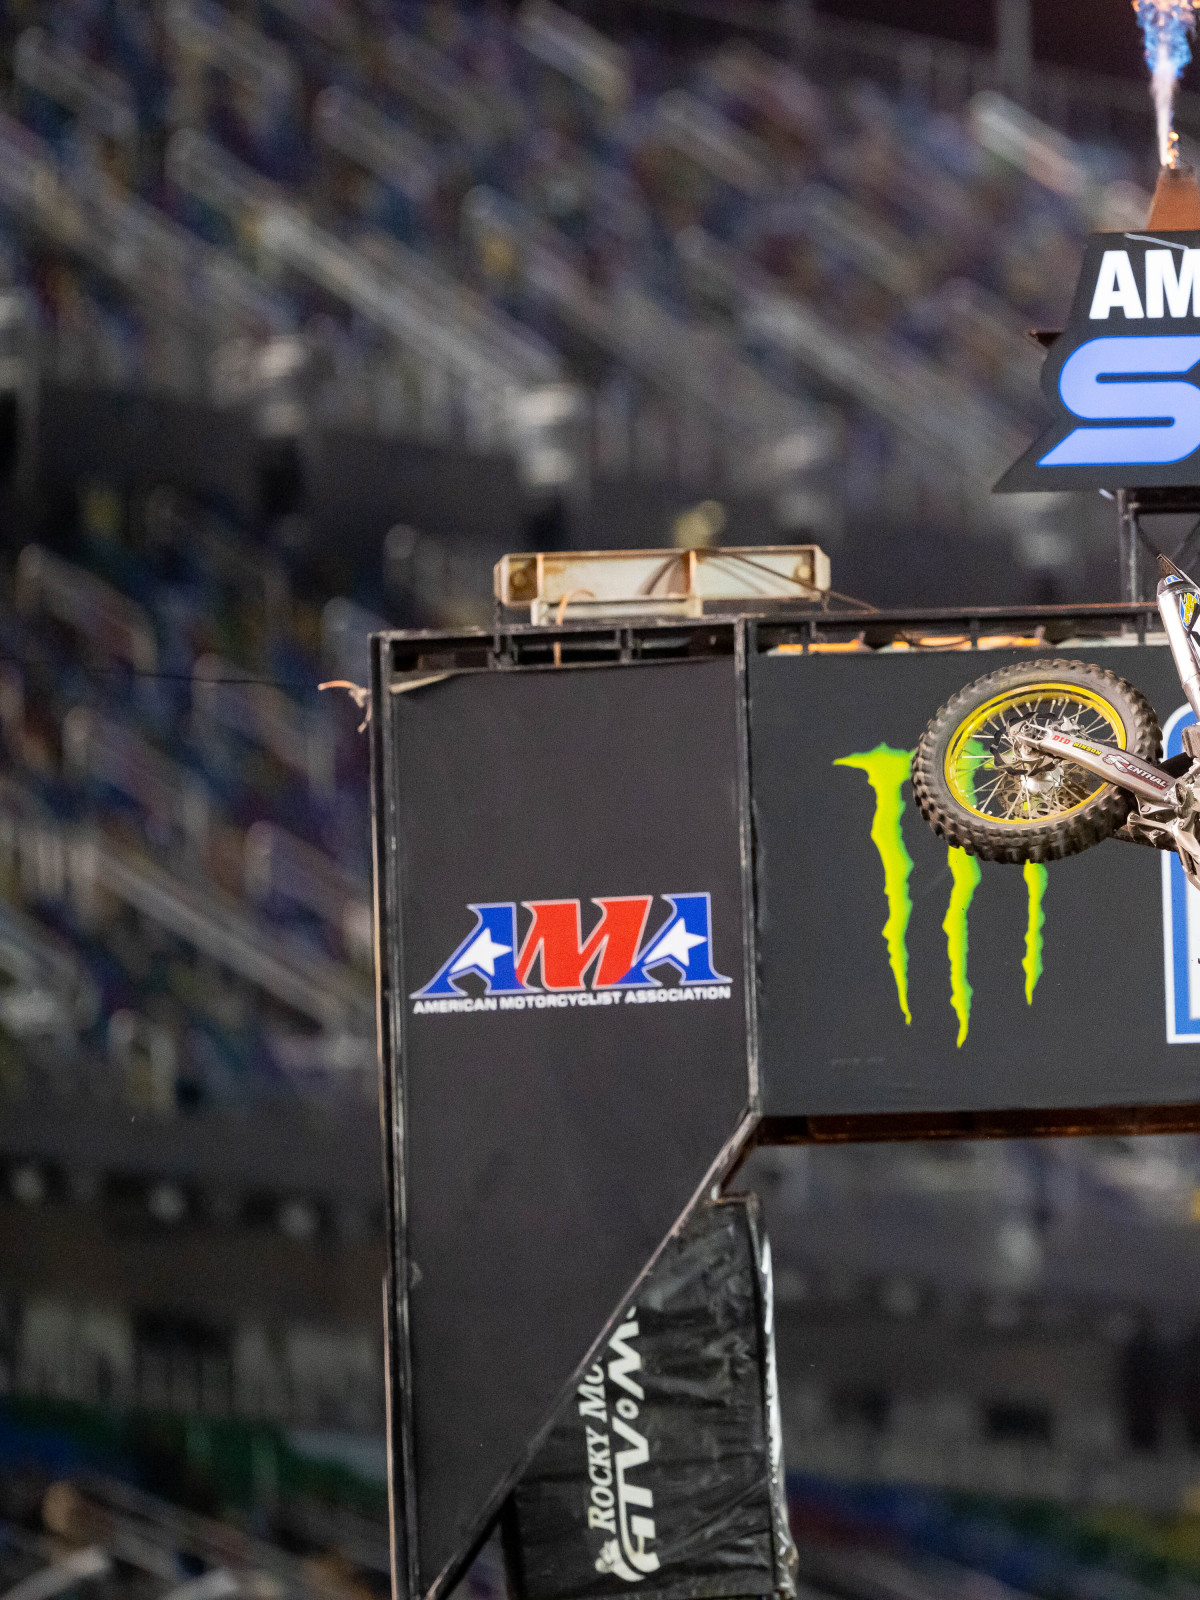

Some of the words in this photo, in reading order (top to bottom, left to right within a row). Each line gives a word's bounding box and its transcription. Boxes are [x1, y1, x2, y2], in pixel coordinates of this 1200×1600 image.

[1052, 734, 1071, 745] DID
[1102, 752, 1168, 790] RENTHAL
[409, 892, 734, 999] AMA
[413, 997, 498, 1014] AMERICAN
[499, 991, 622, 1010] MOTORCYCLIST
[624, 986, 731, 1004] ASSOCIATION
[577, 1357, 608, 1423] MO
[585, 1425, 616, 1534] ROCKY
